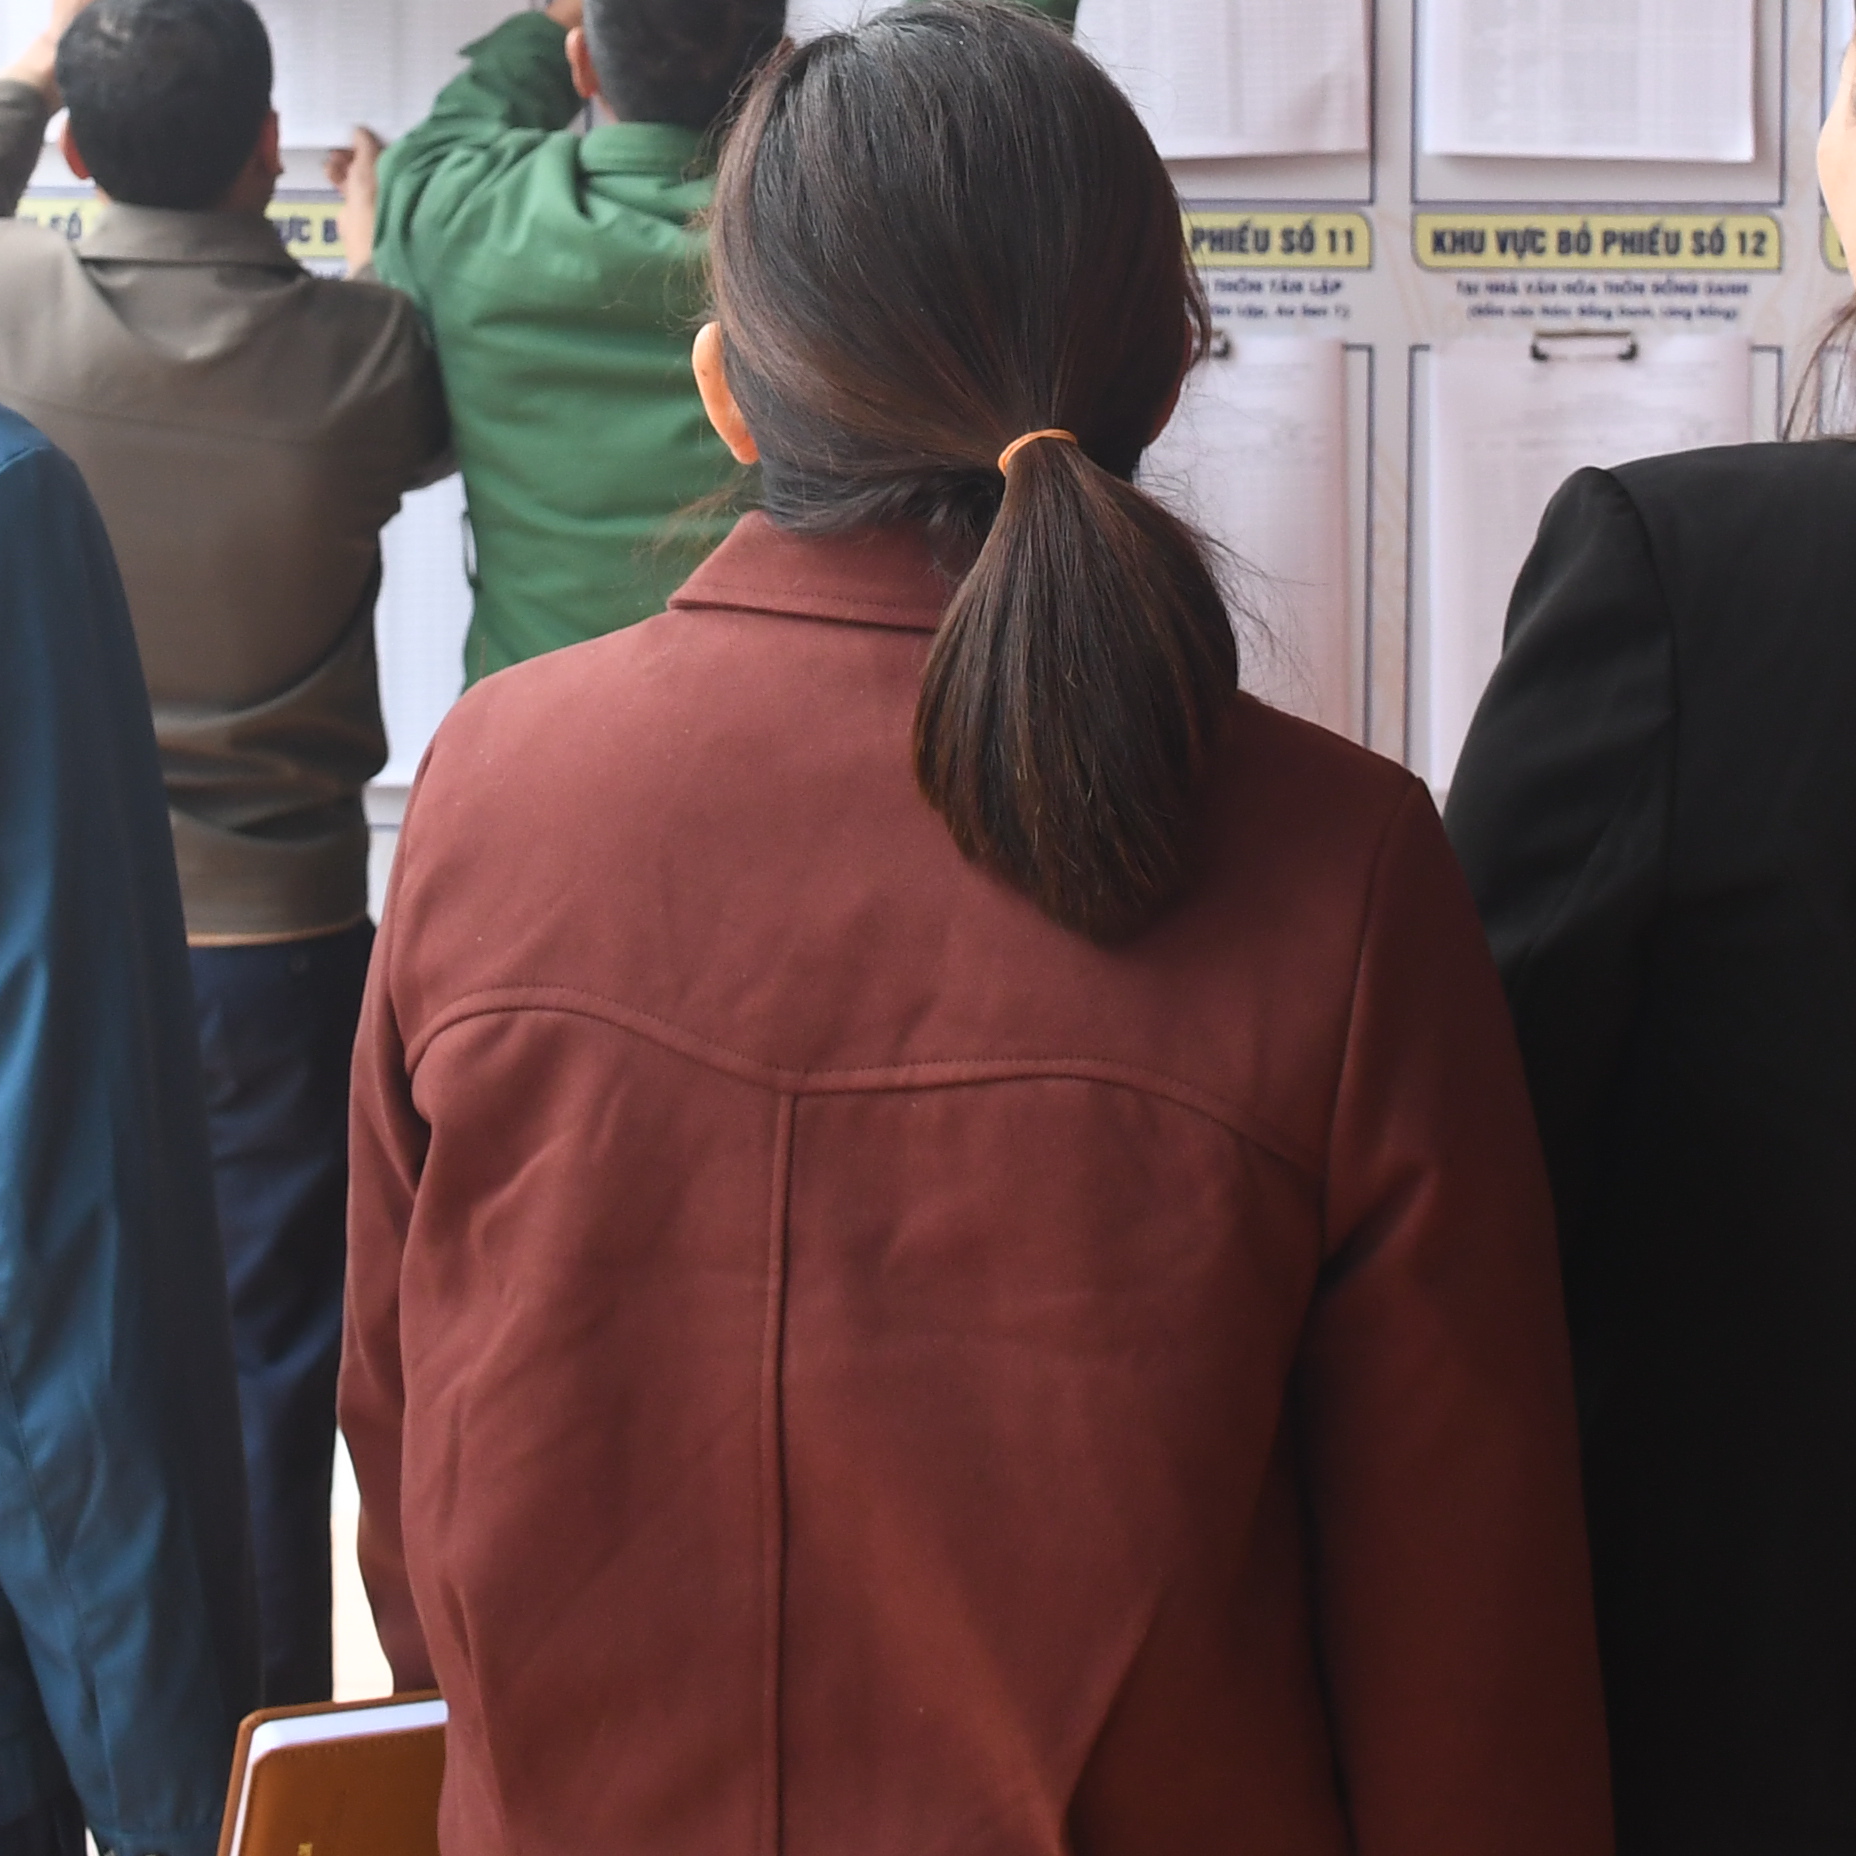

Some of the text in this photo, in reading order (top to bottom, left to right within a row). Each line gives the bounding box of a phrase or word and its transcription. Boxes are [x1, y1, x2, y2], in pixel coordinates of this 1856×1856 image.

[1281, 219, 1316, 255] SỐ
[1328, 228, 1355, 255] 11
[1431, 229, 1487, 256] KHU
[1495, 227, 1546, 260] VỰC
[1601, 223, 1682, 257] PHIẾU
[1691, 222, 1726, 257] SỐ
[1738, 230, 1768, 257] 12
